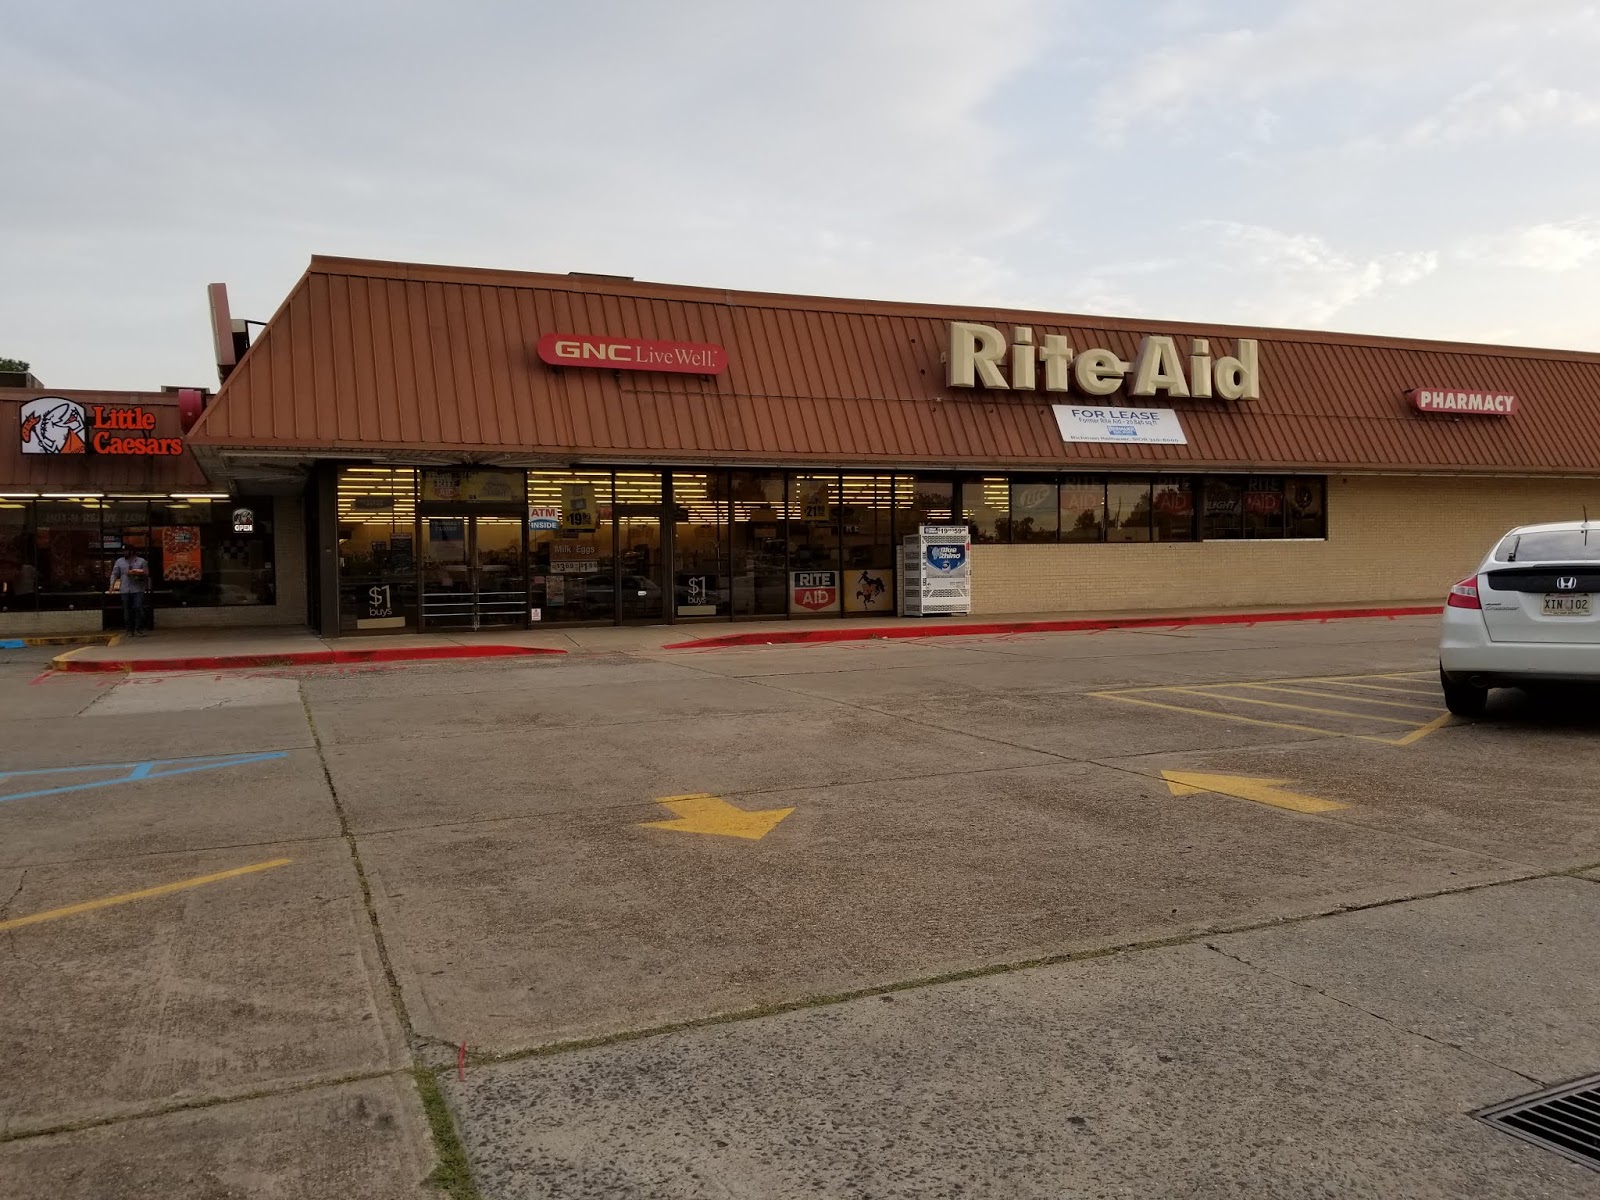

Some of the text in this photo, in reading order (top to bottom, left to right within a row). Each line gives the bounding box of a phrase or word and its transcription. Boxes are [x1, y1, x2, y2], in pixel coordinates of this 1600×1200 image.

[555, 341, 632, 361] GNC
[946, 321, 1260, 401] Rite Aid
[1420, 391, 1515, 412] PHARMACY
[92, 406, 155, 430] Little
[1071, 409, 1160, 420] FOR LEASE
[92, 432, 183, 456] Caesars
[1252, 493, 1276, 510] AID
[530, 508, 556, 518] ATM
[234, 524, 253, 532] OPEN
[530, 521, 557, 529] INSIDE
[554, 545, 595, 555] Milk Eggs
[688, 576, 706, 598] $1
[800, 573, 832, 587] RITE
[368, 585, 391, 609] $1
[687, 595, 707, 606] buys
[802, 590, 829, 605] AID
[1544, 599, 1588, 610] XIN 102
[369, 607, 393, 617] buys
